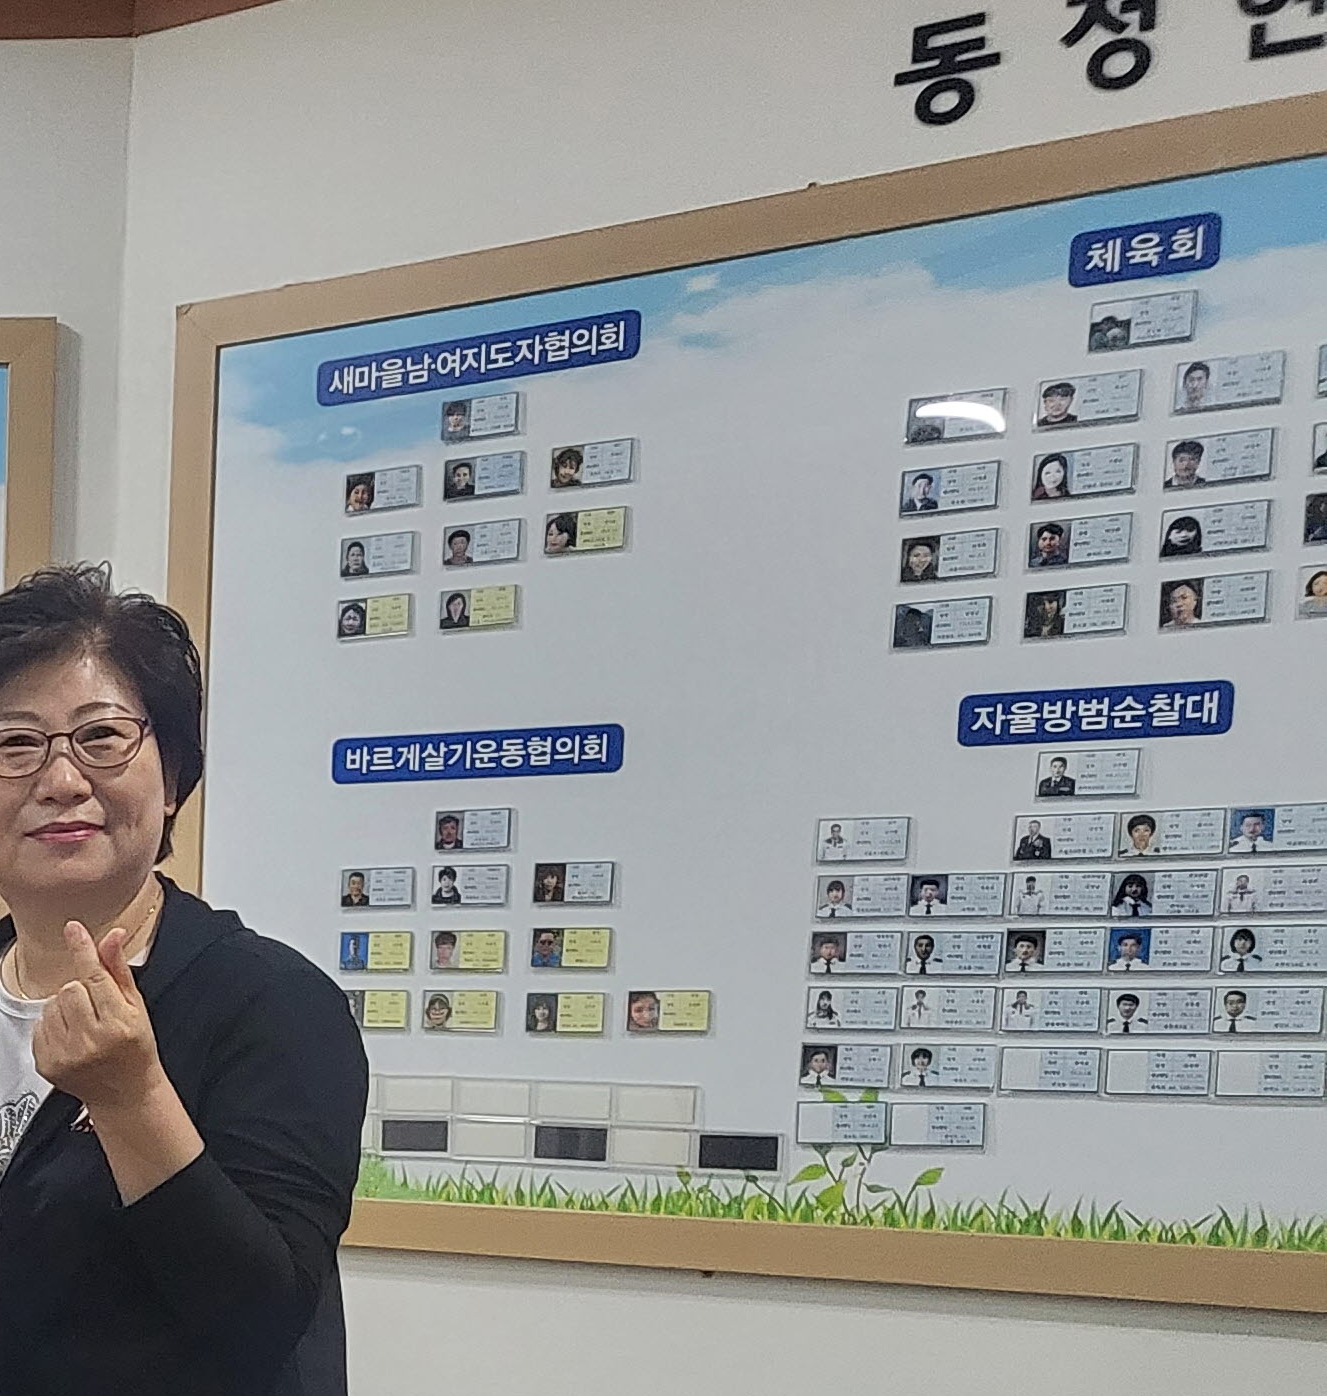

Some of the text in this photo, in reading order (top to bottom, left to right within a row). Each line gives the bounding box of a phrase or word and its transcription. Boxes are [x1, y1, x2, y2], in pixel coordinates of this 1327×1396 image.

[1085, 224, 1207, 274] 체육회
[970, 690, 1220, 736] 자율방범순찰대
[345, 733, 608, 773] 바르게살기운동협의회
